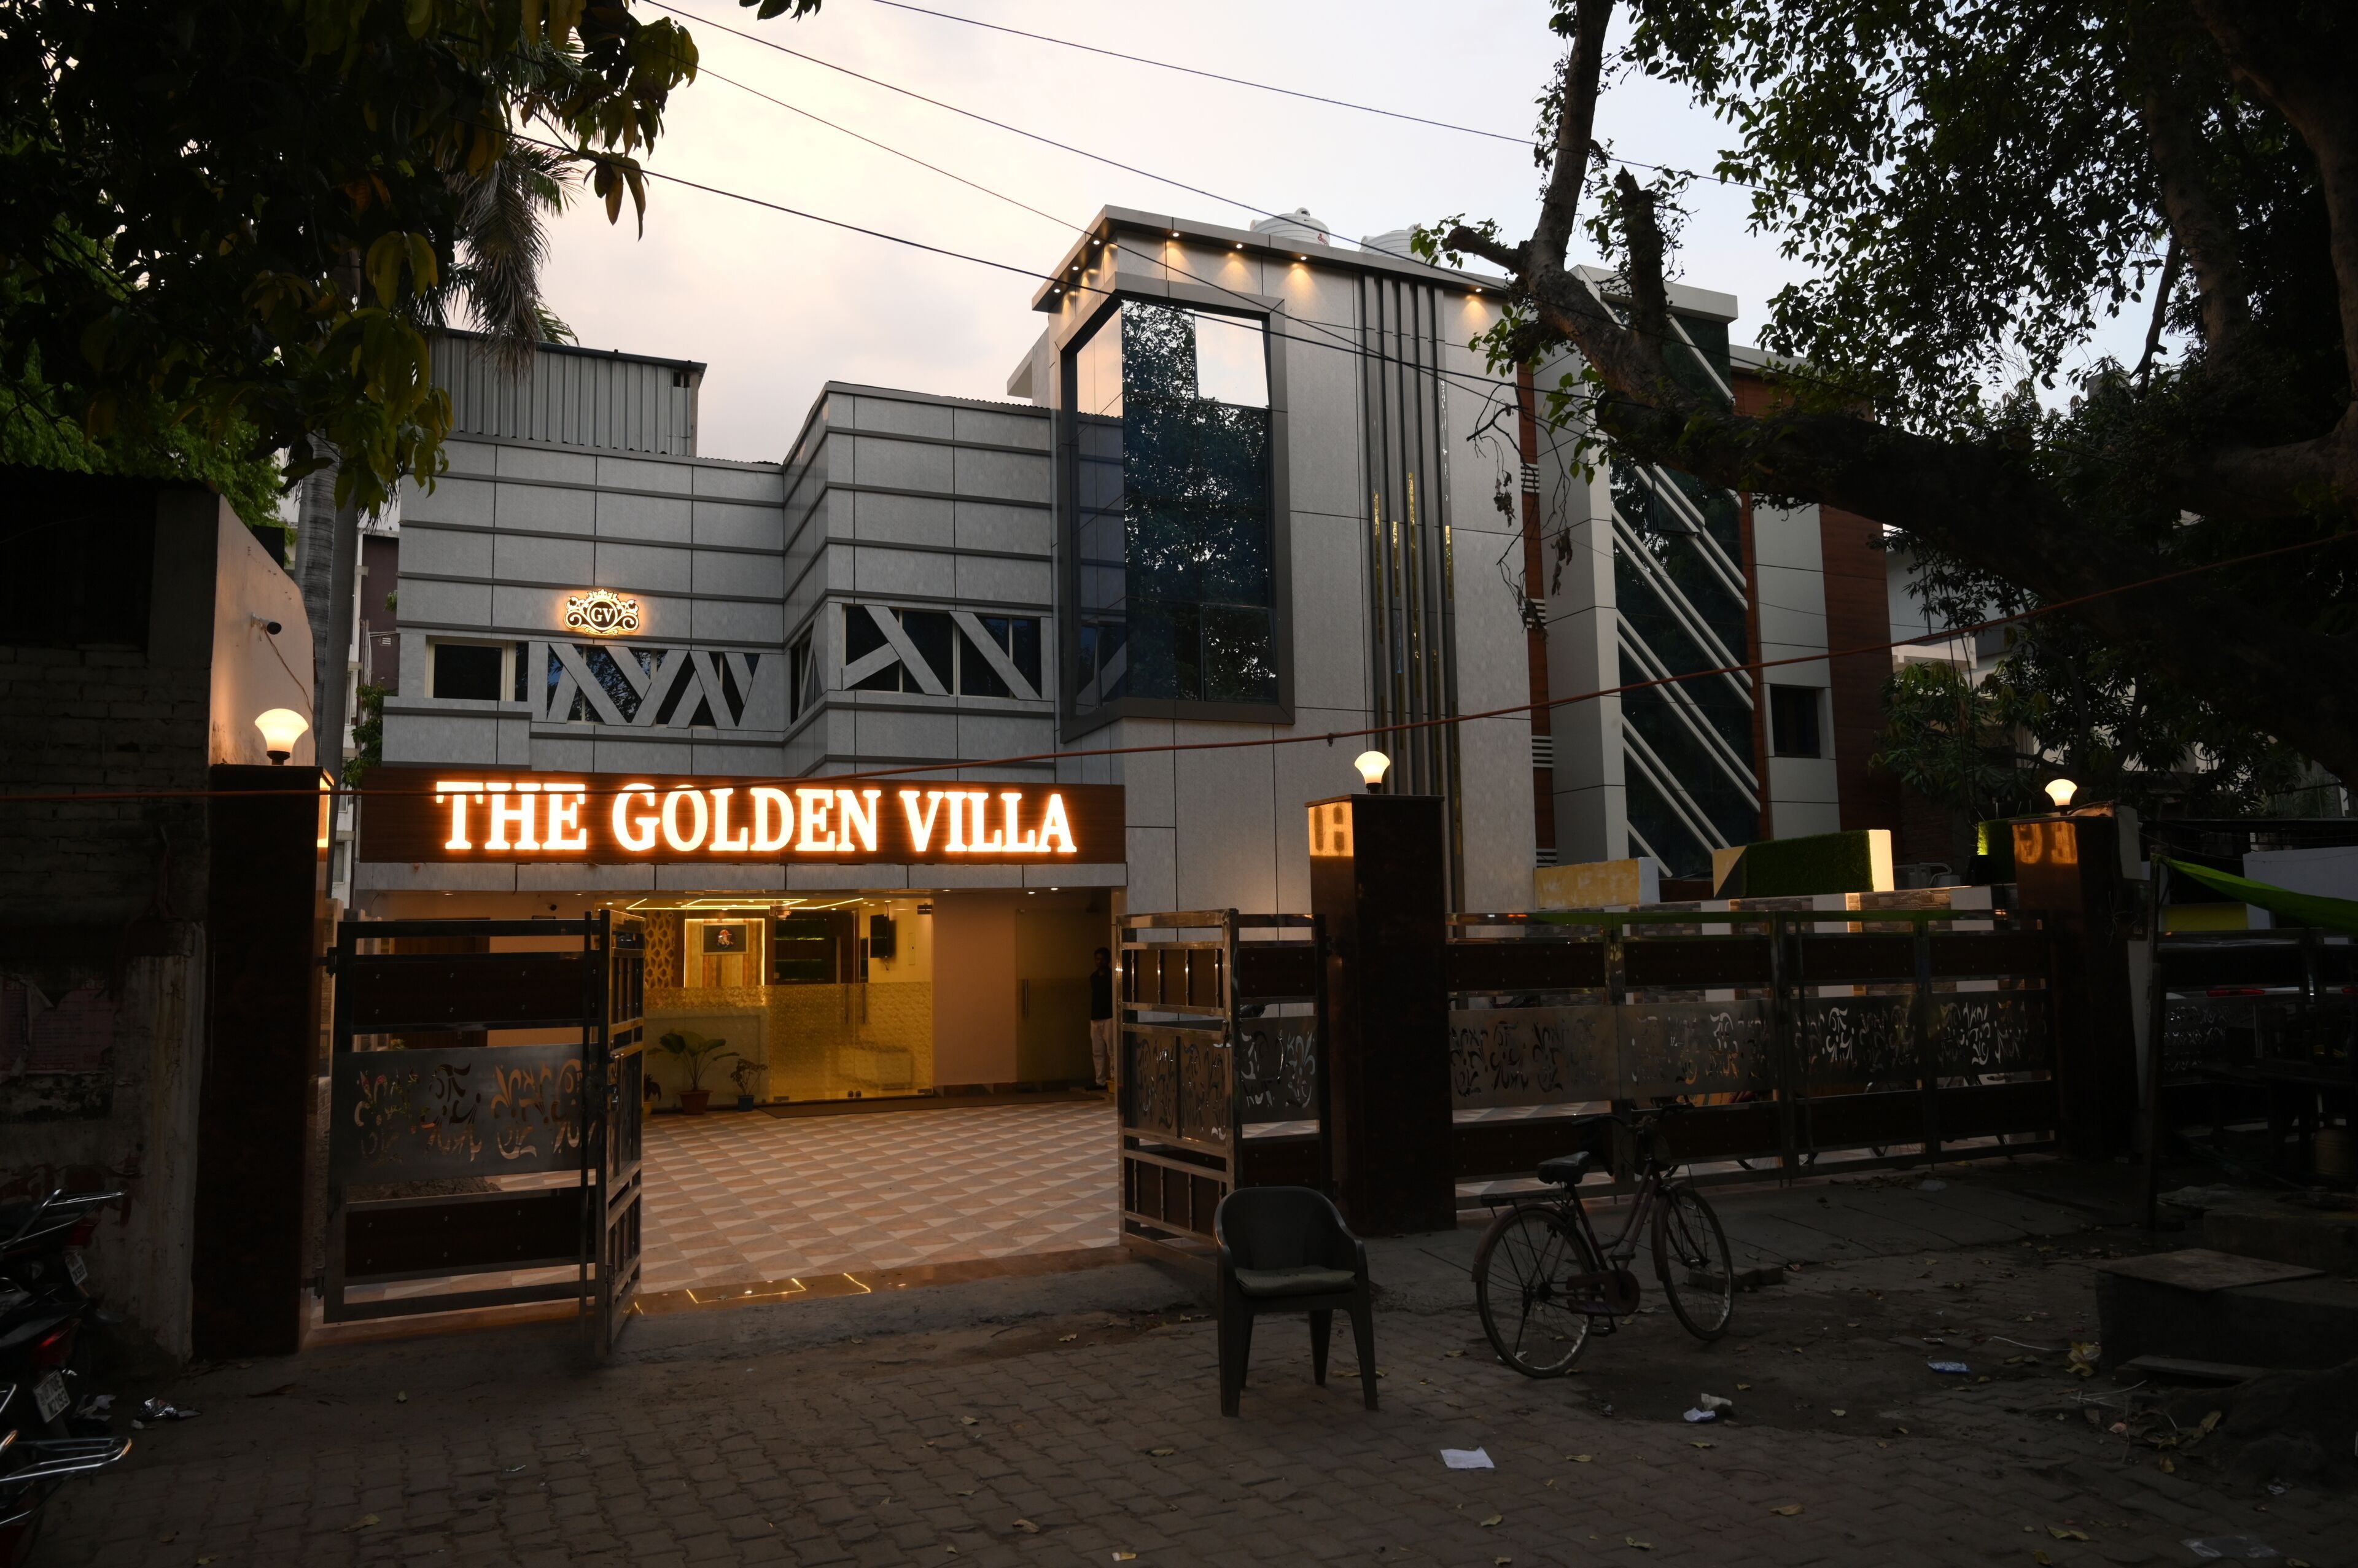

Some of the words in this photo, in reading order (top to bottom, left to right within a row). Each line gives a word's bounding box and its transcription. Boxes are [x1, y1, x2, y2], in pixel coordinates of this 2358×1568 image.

[591, 607, 613, 623] GV
[436, 781, 587, 850] THE
[612, 782, 882, 852] GOLDEN
[899, 790, 1078, 853] VILLA
